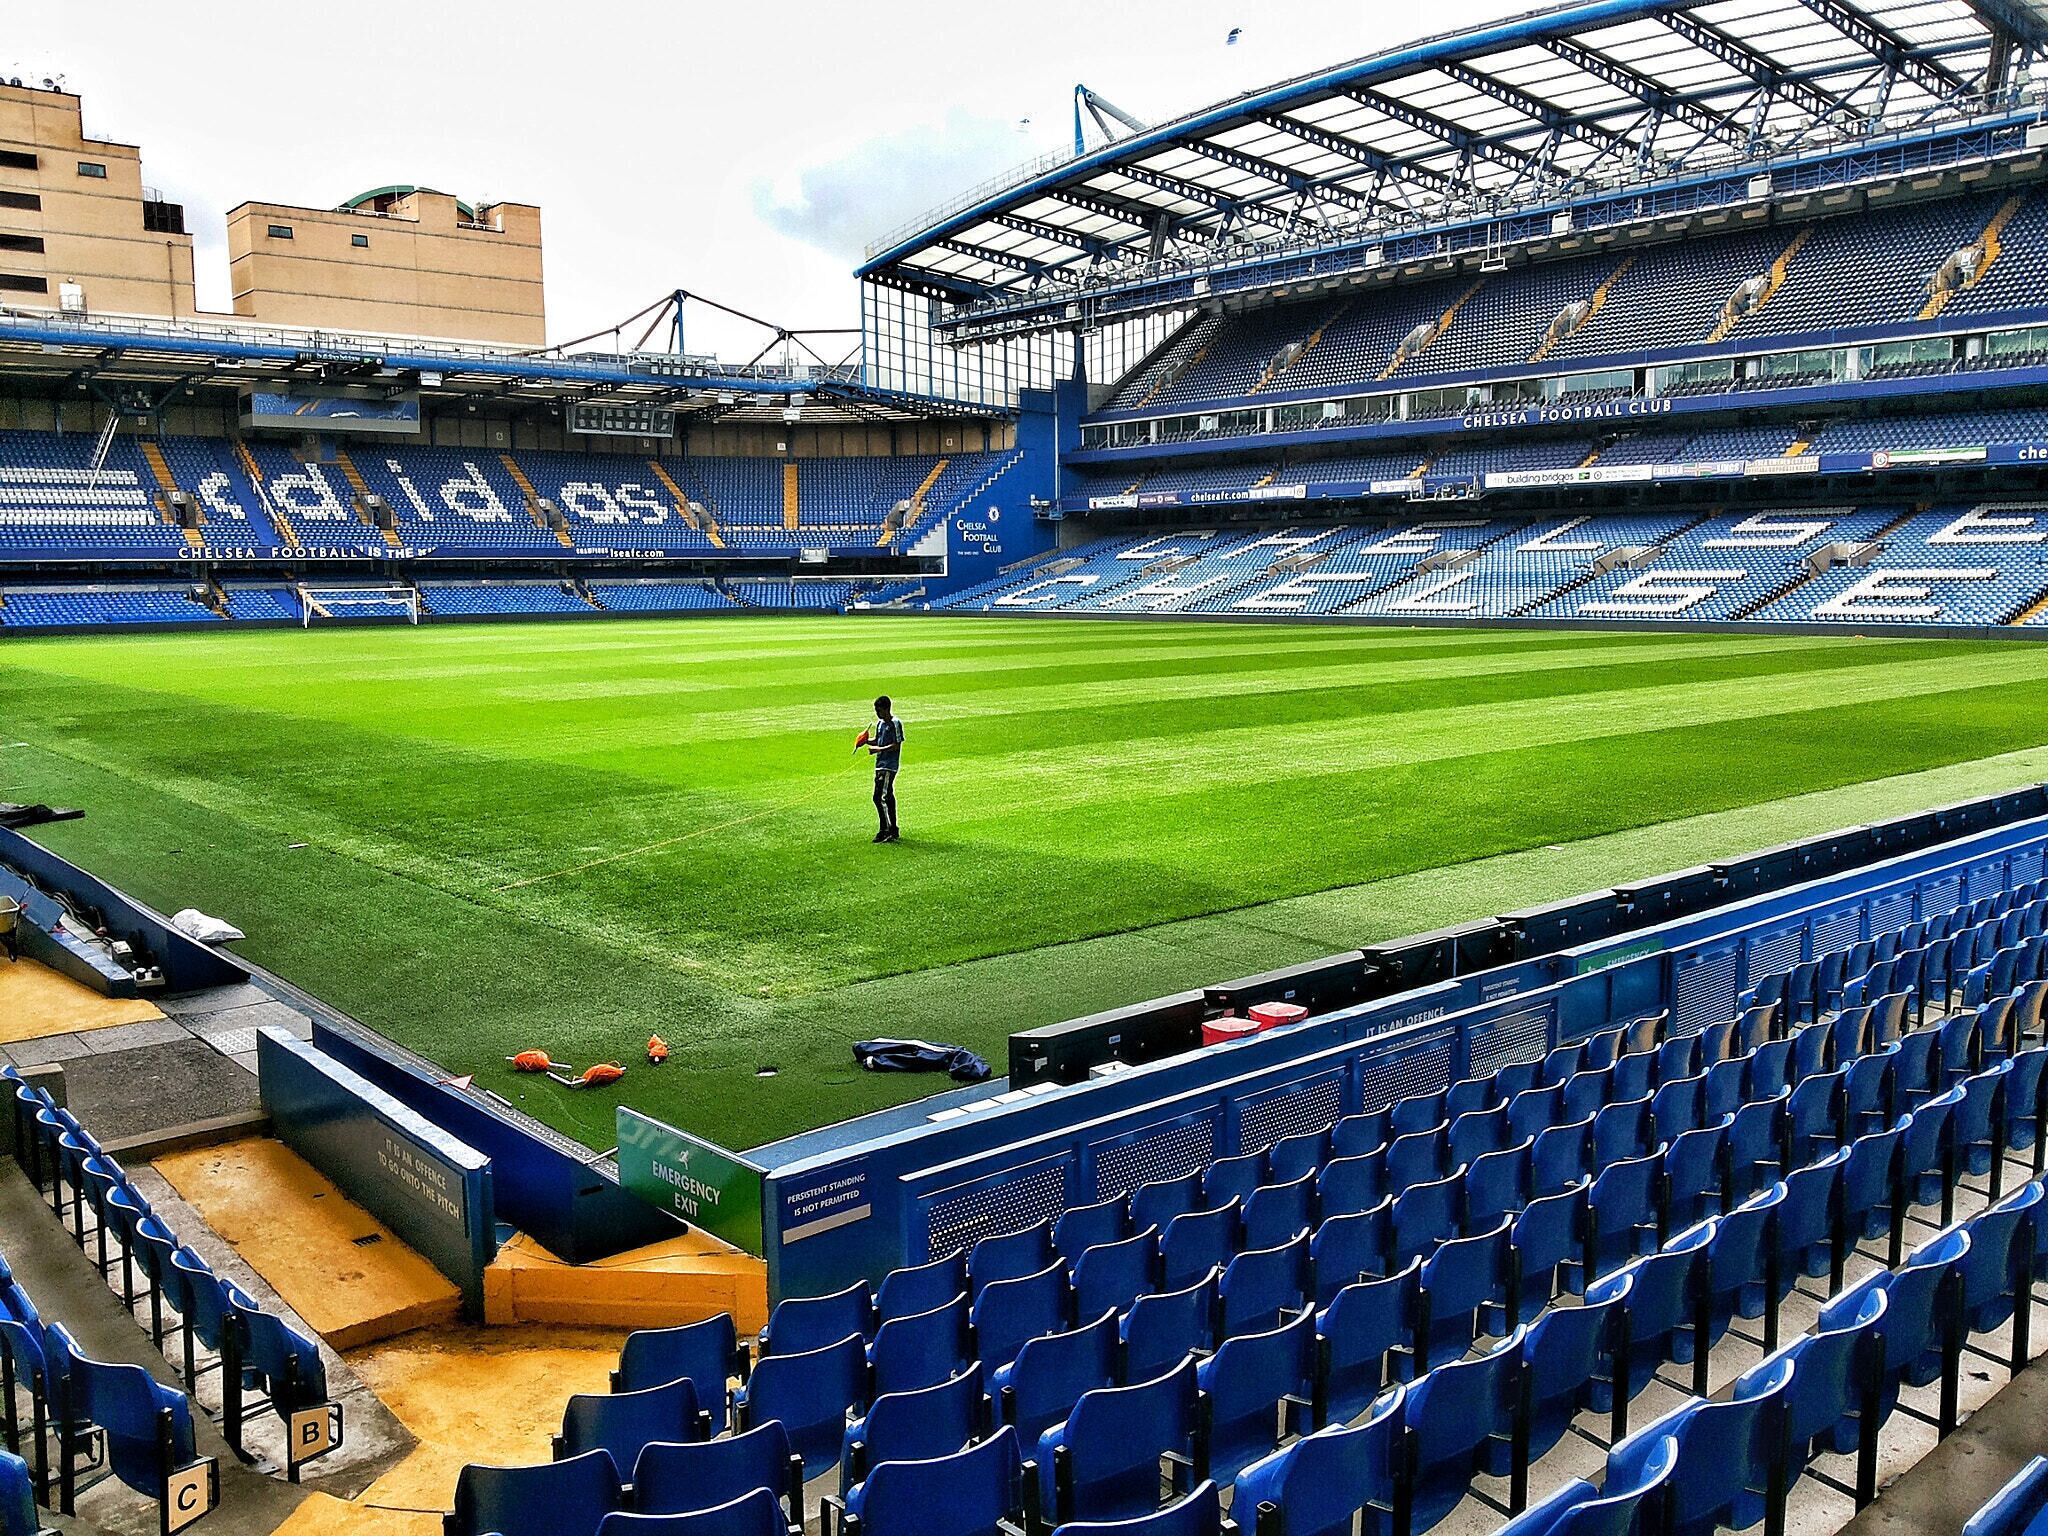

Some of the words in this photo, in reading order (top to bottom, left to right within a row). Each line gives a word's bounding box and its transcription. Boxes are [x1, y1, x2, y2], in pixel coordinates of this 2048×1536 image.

[1463, 412, 1527, 429] CHELSEA
[1540, 404, 1622, 422] FOOTBALL
[1628, 399, 1672, 415] CLUB
[1507, 472, 1541, 484] building
[1541, 471, 1574, 483] bridges
[1190, 491, 1249, 502] chelseafc.com
[956, 520, 987, 530] CHELSEA
[963, 531, 998, 542] FOOTBALL
[178, 547, 256, 559] CHELSEA
[271, 547, 357, 558] FOOTBALL
[368, 546, 382, 557] IS
[386, 548, 415, 559] THE
[983, 542, 1002, 553] CLUB
[1366, 1026, 1376, 1038] IT
[1378, 1023, 1387, 1034] IS
[1389, 1019, 1403, 1031] AN
[1406, 1006, 1445, 1026] OFFENCE
[385, 1138, 392, 1152] IT
[393, 1143, 400, 1158] IS
[402, 1150, 412, 1167] AN
[415, 1158, 447, 1191] OFFENCE
[377, 1150, 387, 1166] TO
[388, 1159, 399, 1175] GO
[400, 1167, 420, 1190] ONTO
[421, 1181, 436, 1203] THE
[437, 1192, 460, 1220] PITCH
[652, 1160, 721, 1206] EMERGENCY
[787, 1184, 828, 1205] PERSISTENT
[829, 1173, 866, 1192] STANDING
[674, 1191, 699, 1217] EXIT
[794, 1207, 801, 1217] IS
[802, 1202, 819, 1214] NOT
[820, 1189, 860, 1209] PERMITTED
[302, 1420, 320, 1446] B
[177, 1482, 198, 1512] C
